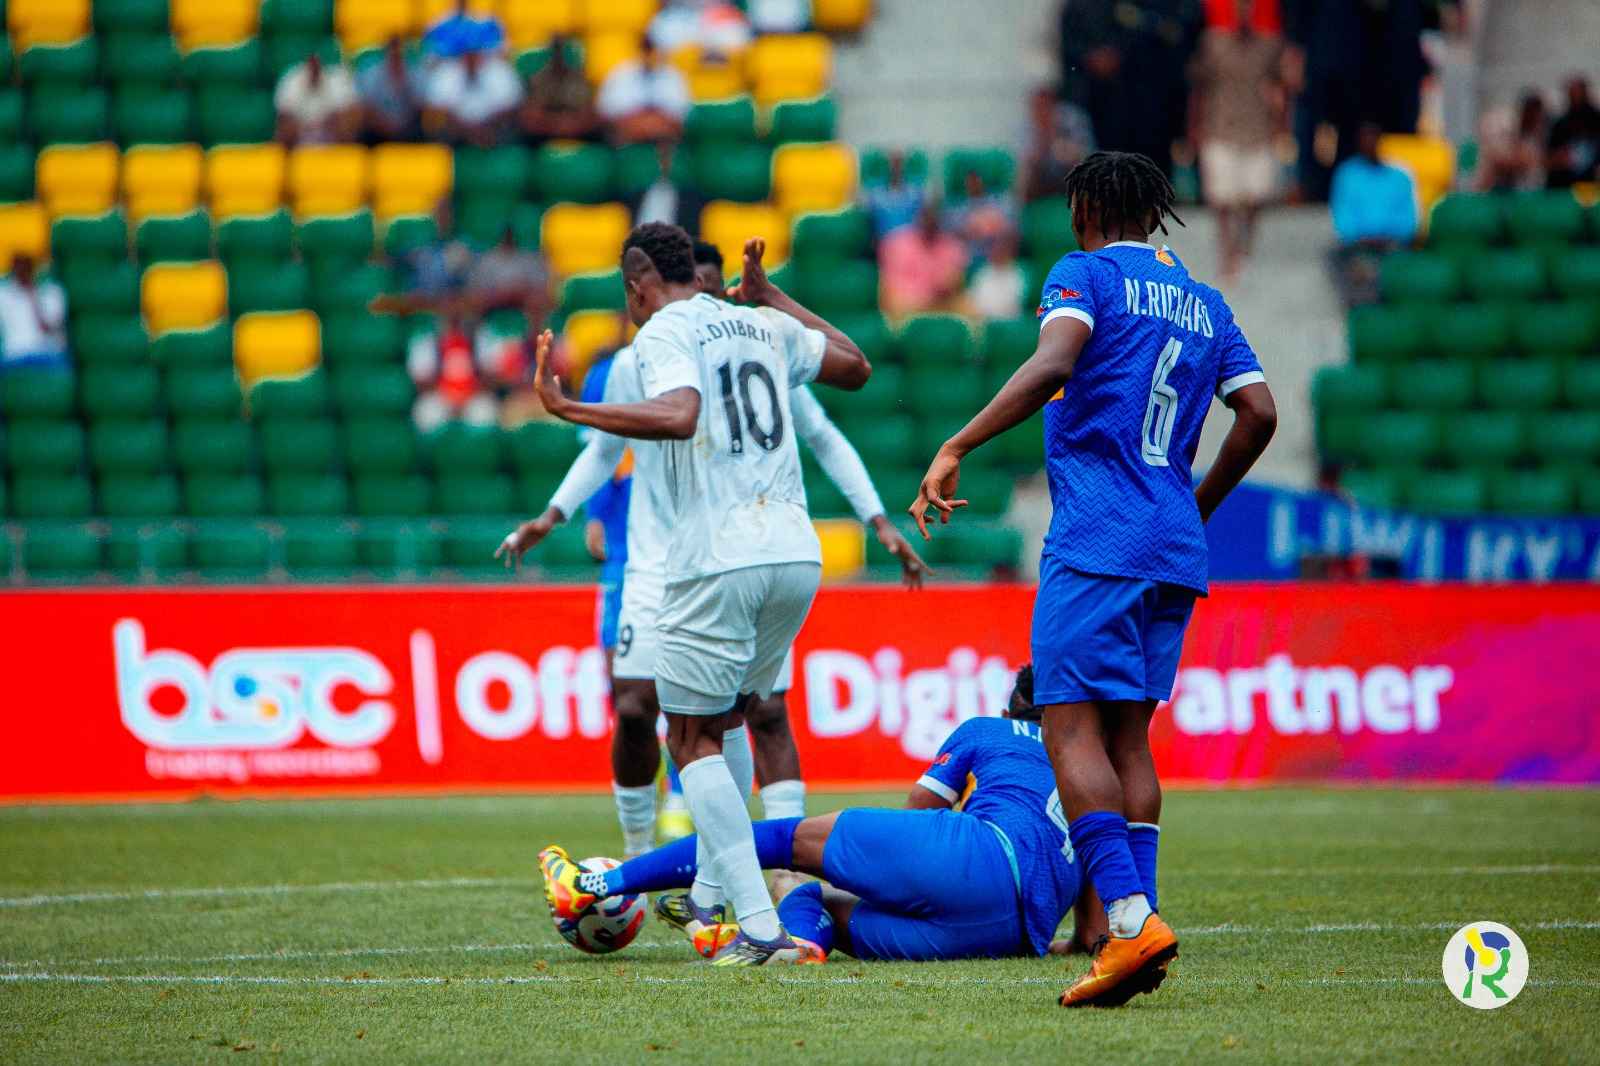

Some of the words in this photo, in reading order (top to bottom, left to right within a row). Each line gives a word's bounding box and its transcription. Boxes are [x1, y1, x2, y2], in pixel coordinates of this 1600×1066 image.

[1124, 278, 1214, 338] N.RICHARD
[717, 360, 784, 454] 10
[1142, 336, 1183, 467] 6
[620, 624, 633, 657] 9
[455, 645, 614, 741] Off
[803, 646, 1018, 762] Digit
[1172, 652, 1455, 735] artner
